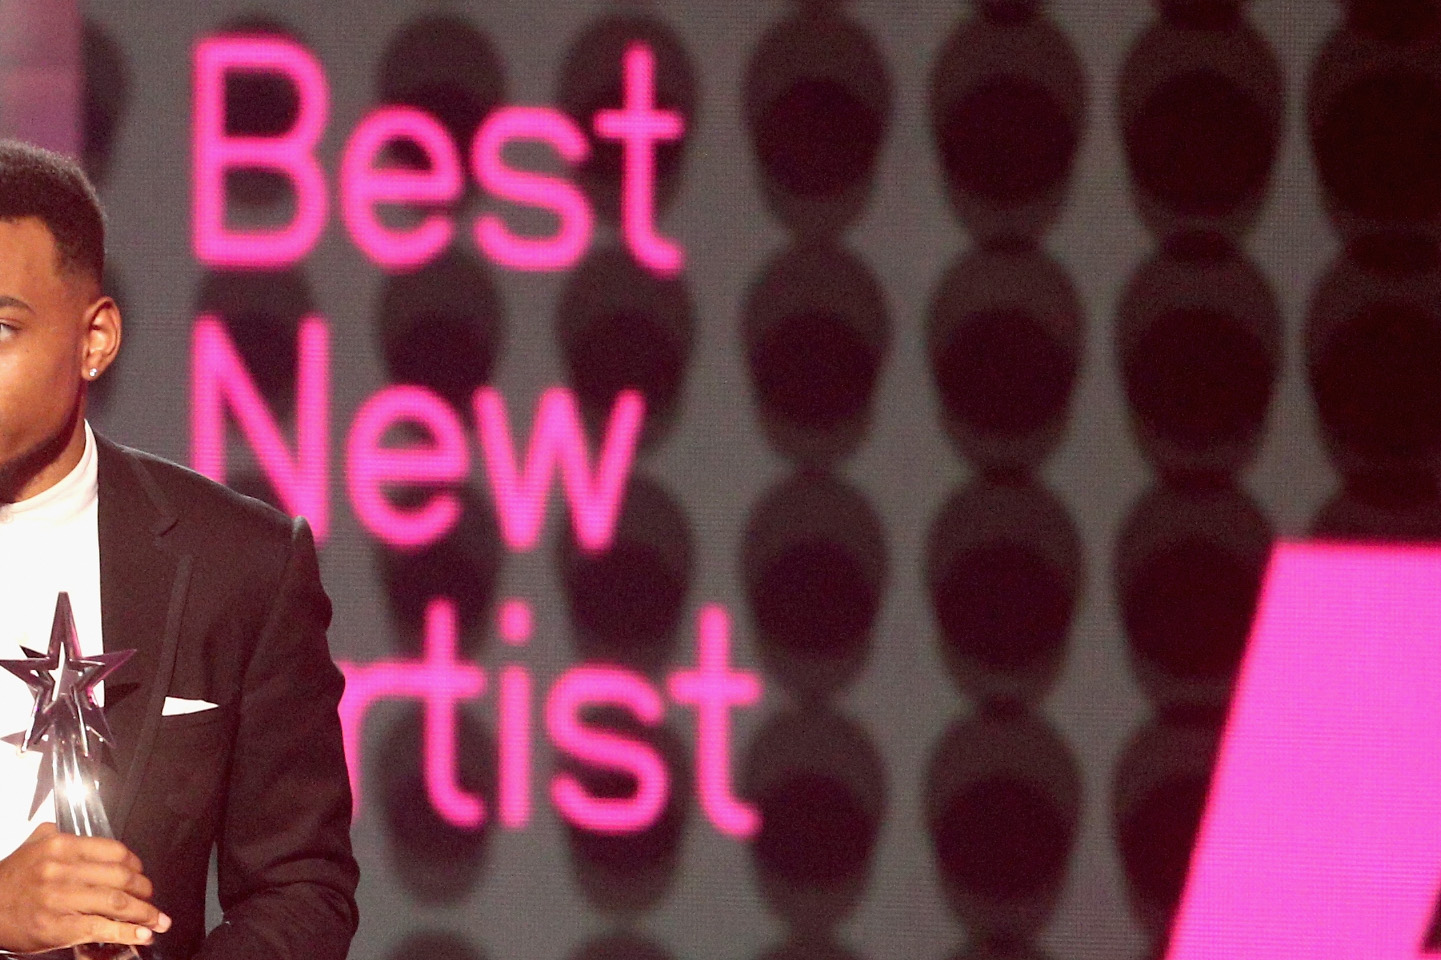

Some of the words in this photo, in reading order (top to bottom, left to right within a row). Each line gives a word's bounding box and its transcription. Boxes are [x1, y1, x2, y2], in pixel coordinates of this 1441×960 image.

[190, 33, 685, 277] Best
[189, 314, 646, 554] New
[334, 598, 764, 840] rtist
